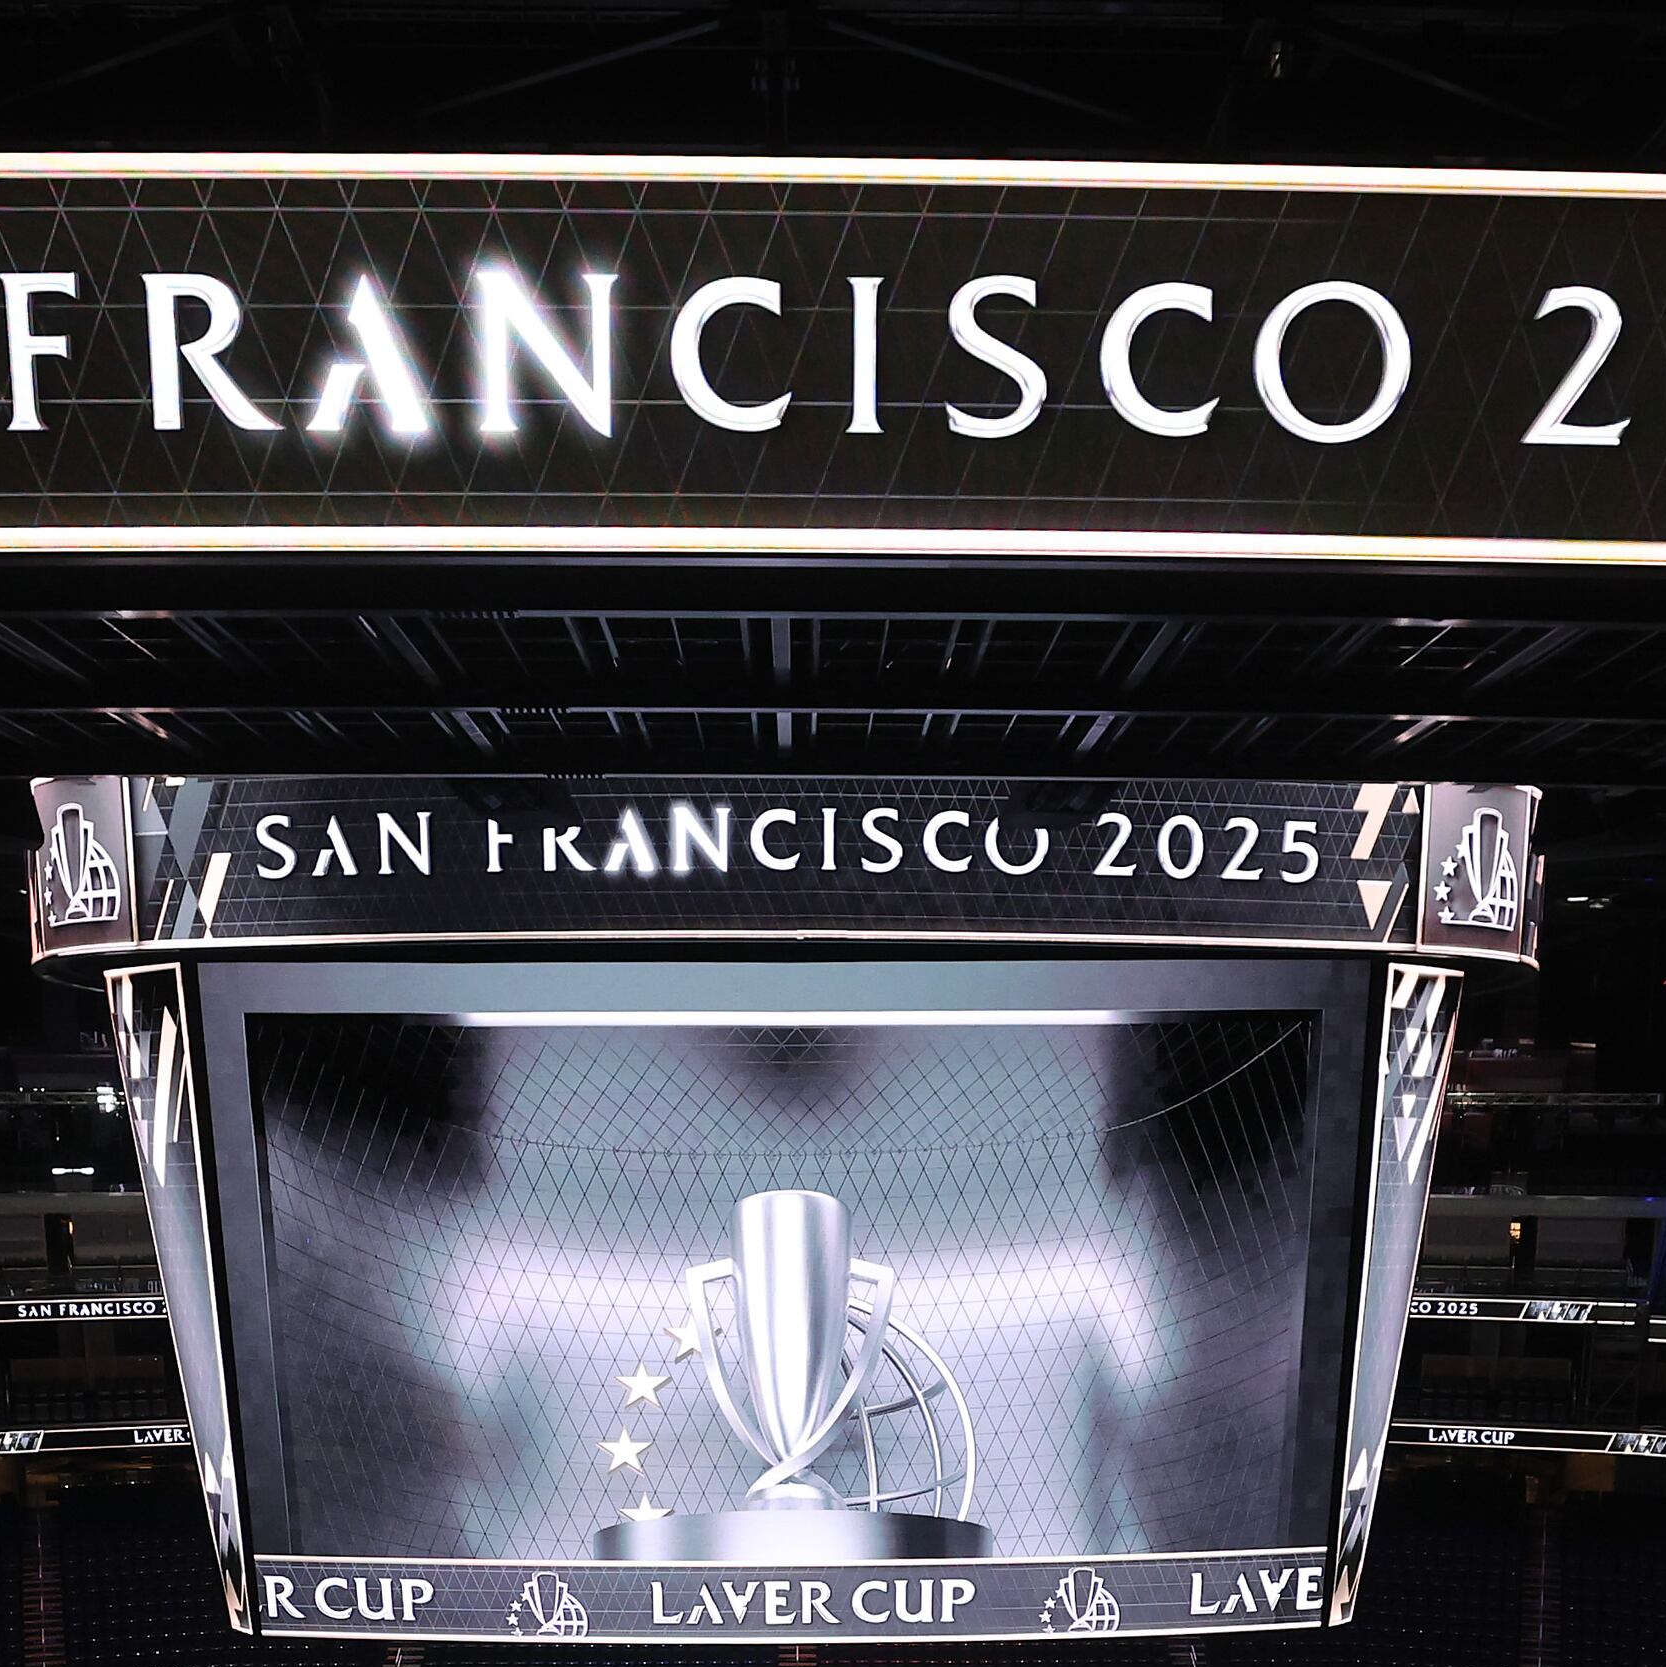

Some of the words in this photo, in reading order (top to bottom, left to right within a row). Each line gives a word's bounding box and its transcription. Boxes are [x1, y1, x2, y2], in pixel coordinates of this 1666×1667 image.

[255, 811, 431, 881] SAN
[1094, 811, 1321, 885] 2025
[18, 1303, 51, 1317] SAN
[58, 1301, 156, 1317] FRANCISCO
[1436, 1302, 1478, 1316] 2025
[134, 1429, 185, 1444] LAVER
[1429, 1428, 1479, 1444] LAVER
[1480, 1431, 1516, 1446] CUP
[314, 1576, 434, 1621] CUP
[650, 1579, 842, 1625] LAVER
[851, 1578, 976, 1624] CUP
